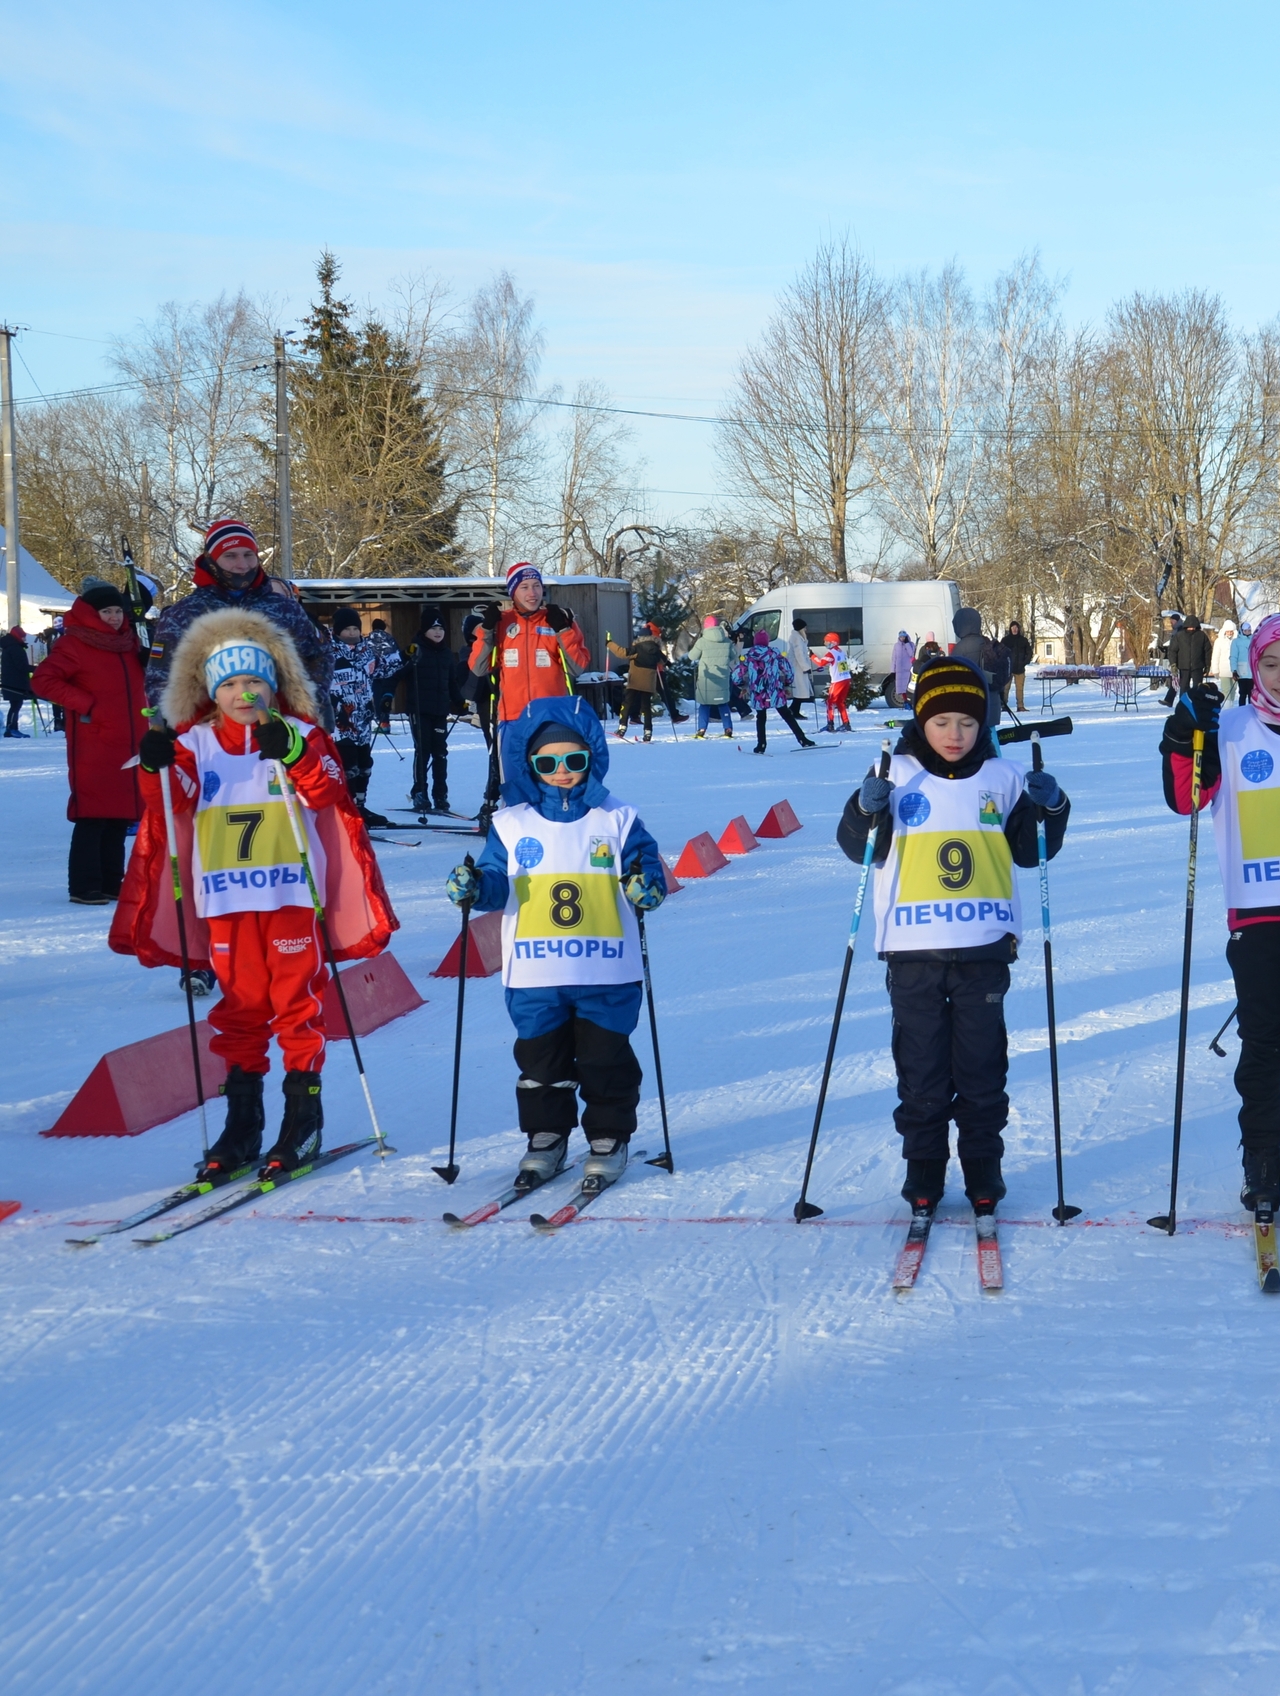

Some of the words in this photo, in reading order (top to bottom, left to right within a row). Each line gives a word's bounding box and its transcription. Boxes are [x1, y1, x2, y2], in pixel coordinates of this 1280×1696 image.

[226, 810, 264, 861] 7
[937, 838, 975, 891] 9
[549, 880, 584, 929] 8
[895, 901, 1015, 927] ПЕЧОРЫ
[515, 939, 624, 959] ПЕЧОРЫ
